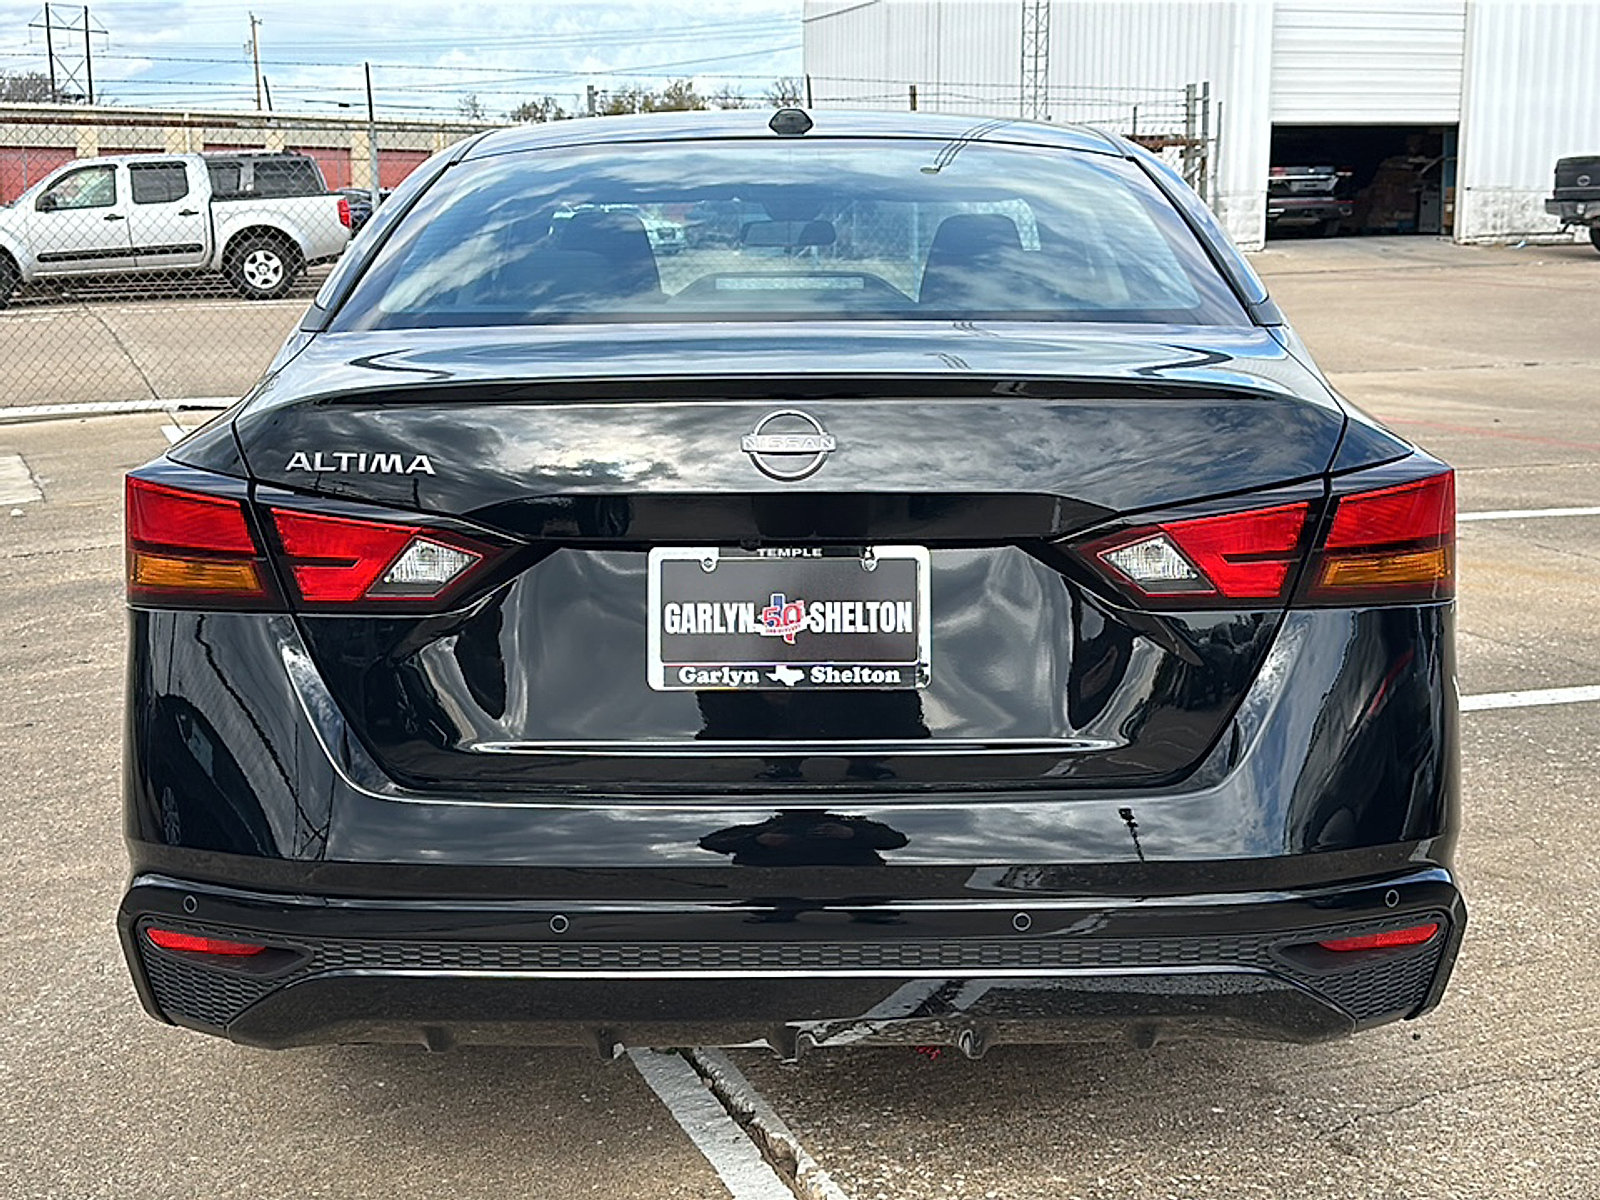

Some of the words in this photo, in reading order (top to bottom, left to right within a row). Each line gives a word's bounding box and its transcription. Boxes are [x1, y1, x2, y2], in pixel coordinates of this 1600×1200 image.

[742, 435, 836, 450] NISSAN
[285, 451, 436, 476] ALTIMA
[757, 548, 822, 558] TEMPLE
[664, 602, 755, 633] GARLYN
[809, 602, 912, 633] SHELTON
[678, 667, 759, 685] Garlyn
[810, 667, 901, 683] Shelton
